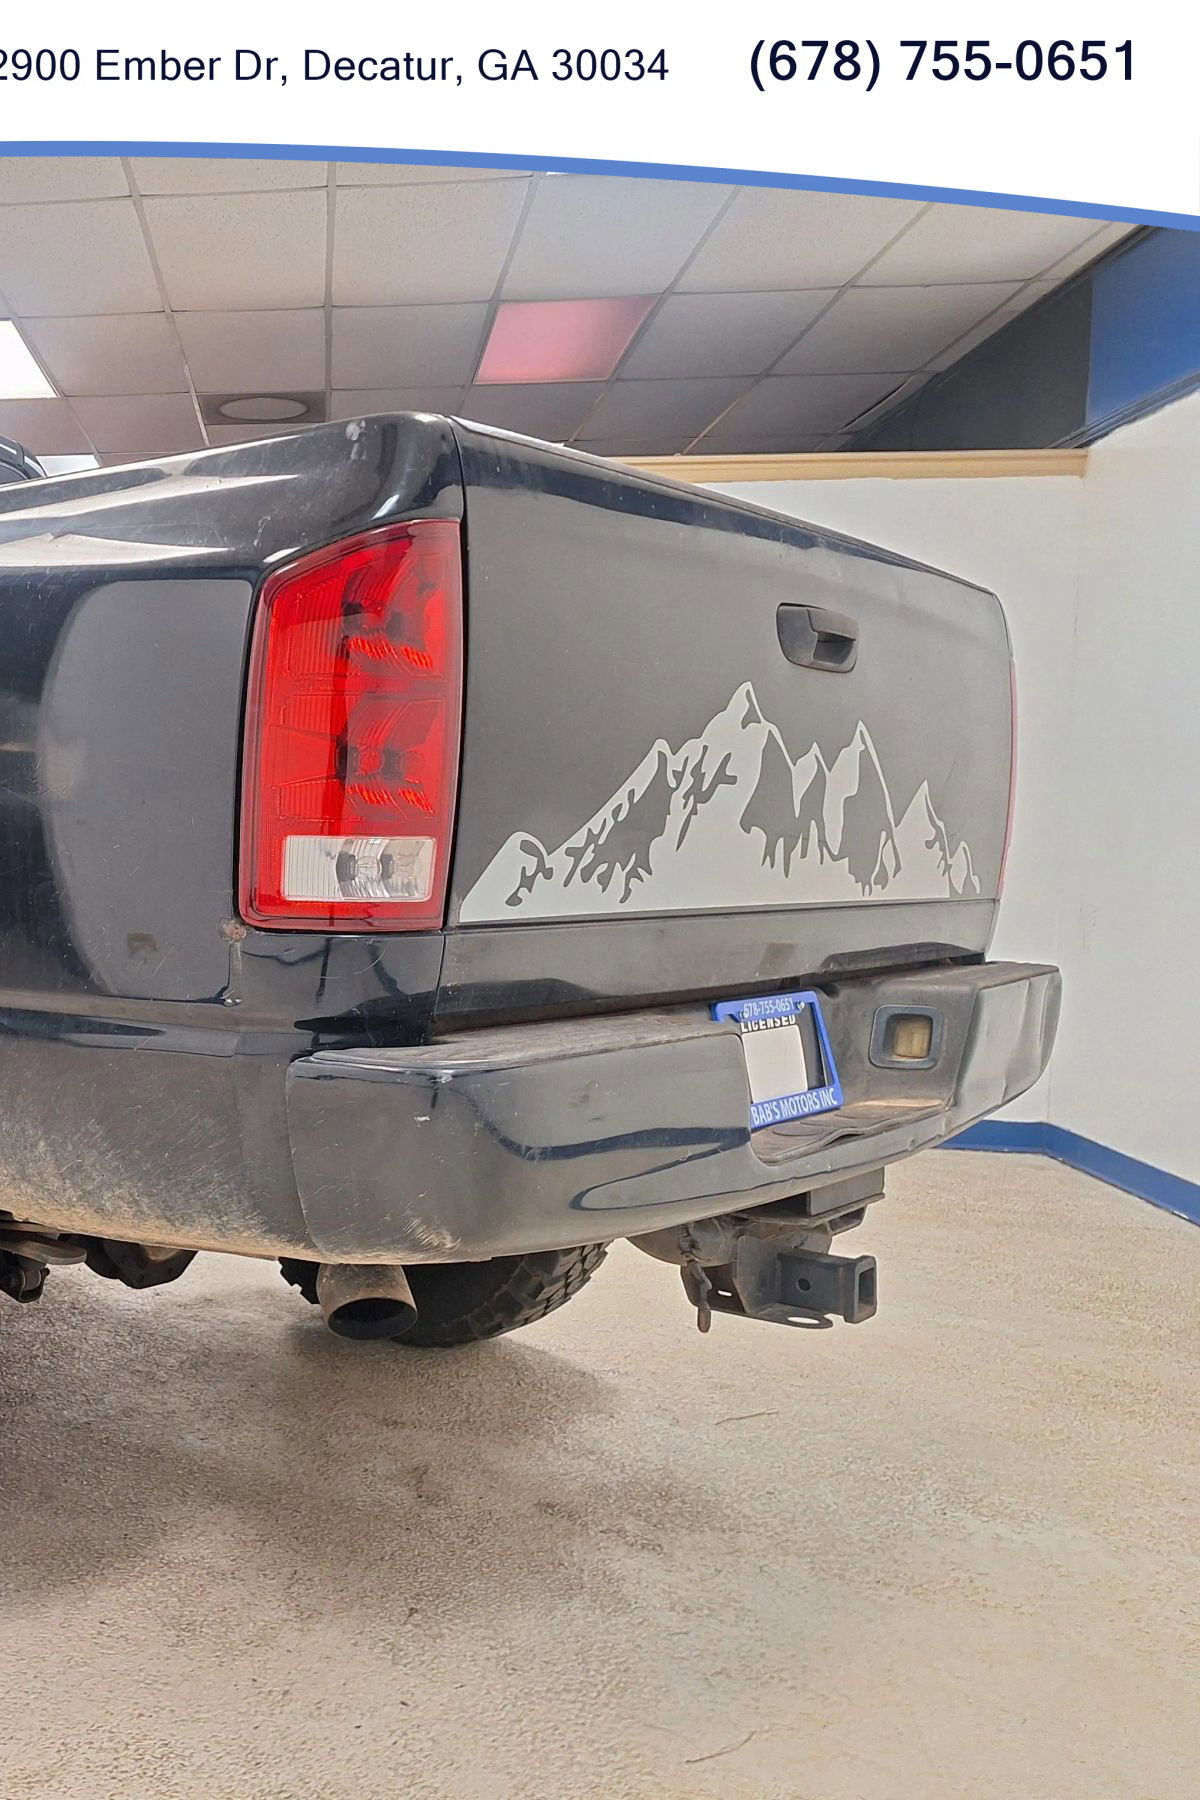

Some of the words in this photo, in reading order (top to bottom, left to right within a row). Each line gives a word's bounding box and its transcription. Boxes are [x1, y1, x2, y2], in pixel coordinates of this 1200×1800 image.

[743, 997, 795, 1018] 678-755-0651
[751, 1102, 780, 1125] BAB'S
[780, 1090, 820, 1118] MOTORS
[819, 1087, 838, 1107] INC
